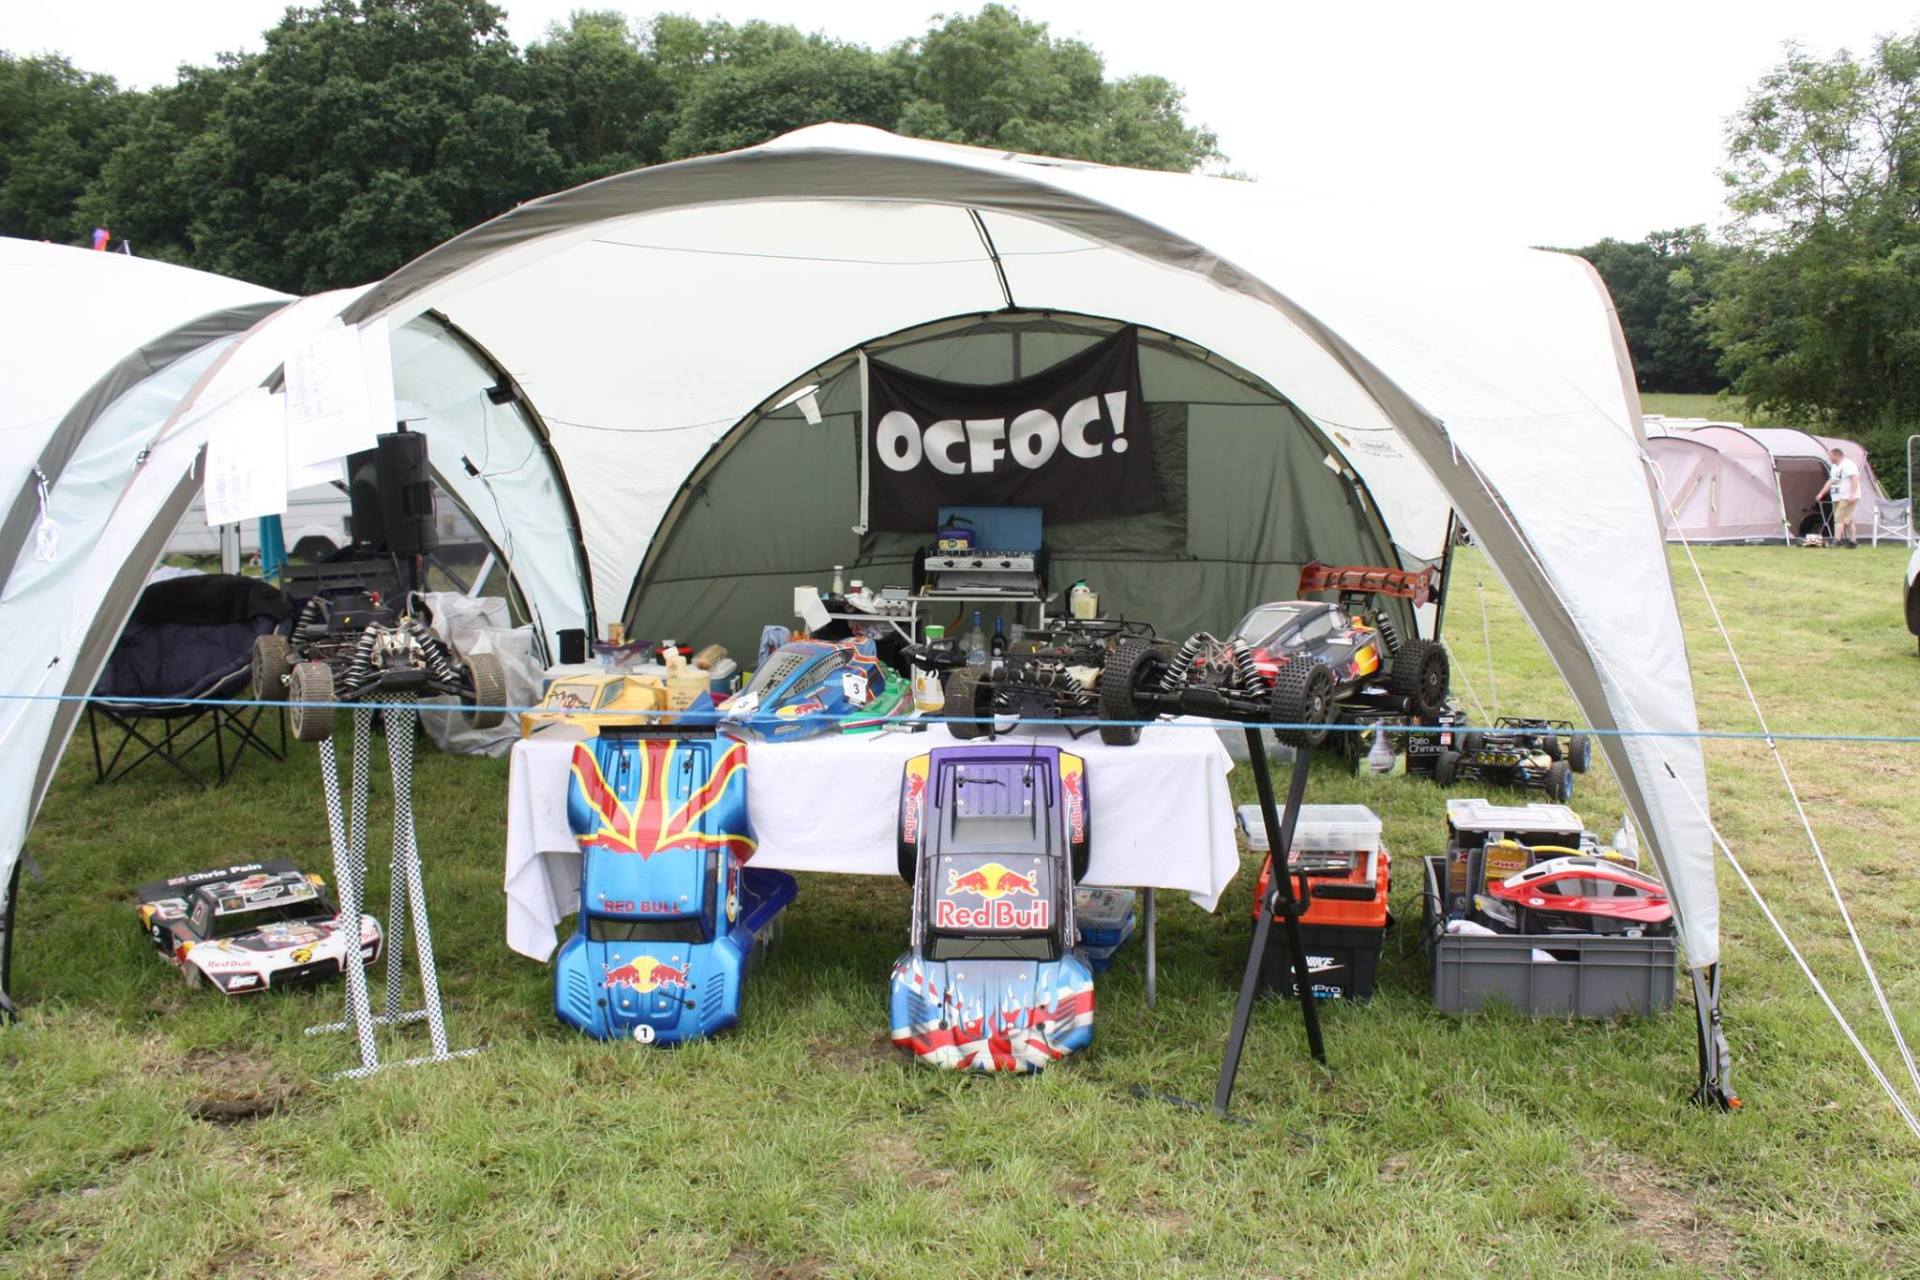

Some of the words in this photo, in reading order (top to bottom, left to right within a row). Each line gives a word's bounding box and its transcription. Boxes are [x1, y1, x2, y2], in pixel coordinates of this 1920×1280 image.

[876, 390, 1128, 475] OCFOC!
[852, 683, 860, 695] 3
[1409, 736, 1430, 745] Patio
[1492, 860, 1521, 869] 4WD
[188, 869, 228, 882] Chris
[230, 863, 263, 874] Pain
[604, 900, 635, 913] RED
[640, 901, 682, 914] BULL
[936, 900, 990, 928] Red
[995, 900, 1049, 930] Bull
[1293, 984, 1341, 993] GPro
[641, 1027, 648, 1039] 1
